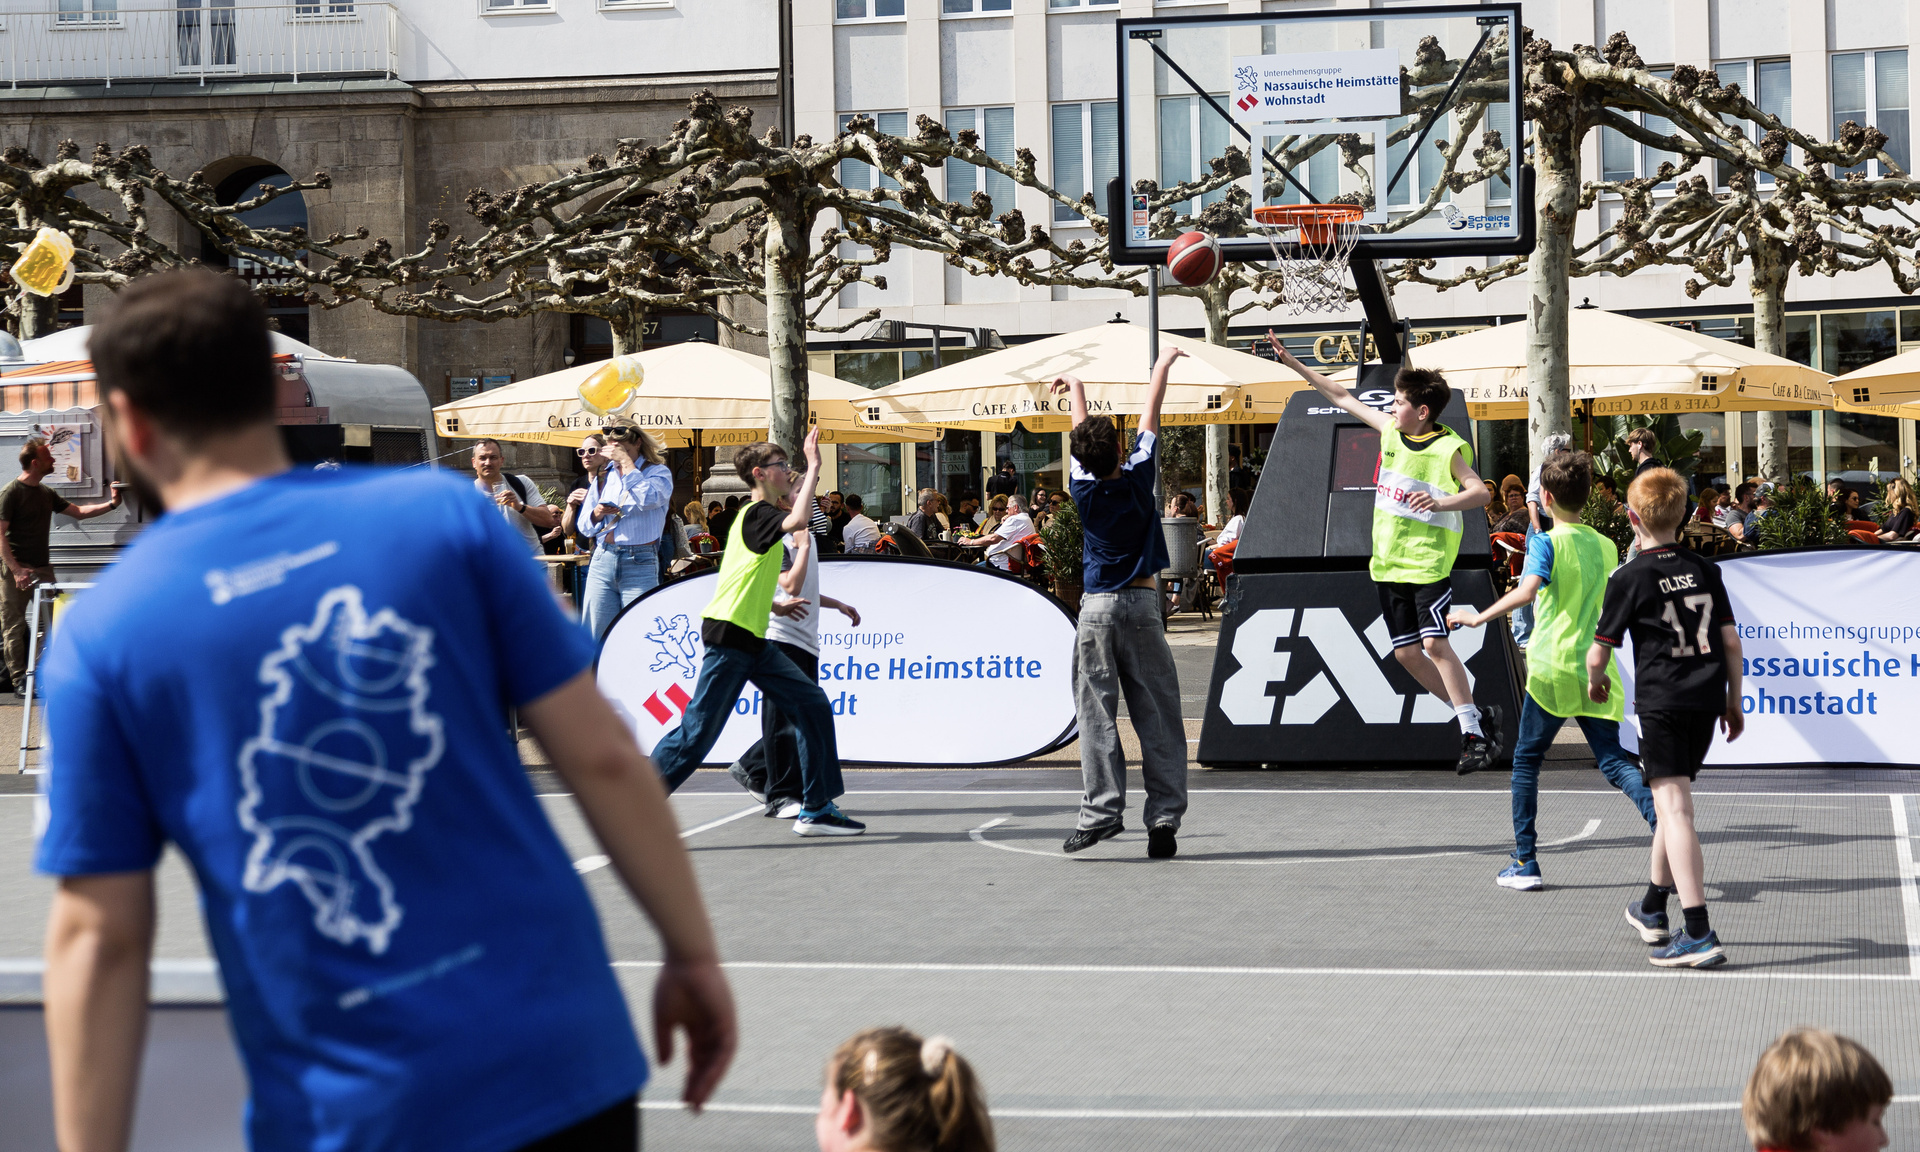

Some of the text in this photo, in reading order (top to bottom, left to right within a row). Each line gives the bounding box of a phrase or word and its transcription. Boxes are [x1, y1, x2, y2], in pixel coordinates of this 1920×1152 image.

[1263, 66, 1342, 78] Unternehmensgruppe
[1264, 75, 1399, 92] Nassauische Heimstätte
[1264, 93, 1326, 106] Wohnstadt
[1467, 221, 1511, 230] Sports
[642, 321, 659, 335] 57
[1313, 332, 1380, 364] CAF
[1463, 383, 1598, 399] FE & BAR ONA
[1772, 382, 1786, 398] CAFE
[1786, 387, 1792, 398] &
[1794, 384, 1803, 399] BA
[972, 397, 1113, 416] CAFE & BAR CONA
[547, 415, 581, 429] CAFE
[584, 417, 593, 427] &
[631, 412, 683, 426] CELONA
[1377, 484, 1391, 498] ort
[1659, 573, 1698, 594] OLISE
[1661, 593, 1714, 658] 17
[1737, 621, 1920, 644] ternehmensgrupp
[817, 632, 905, 650] ensgruppe
[888, 655, 1042, 680] Heimstätte
[1742, 650, 1901, 677] ssauische
[1741, 687, 1878, 715] ohnstadt
